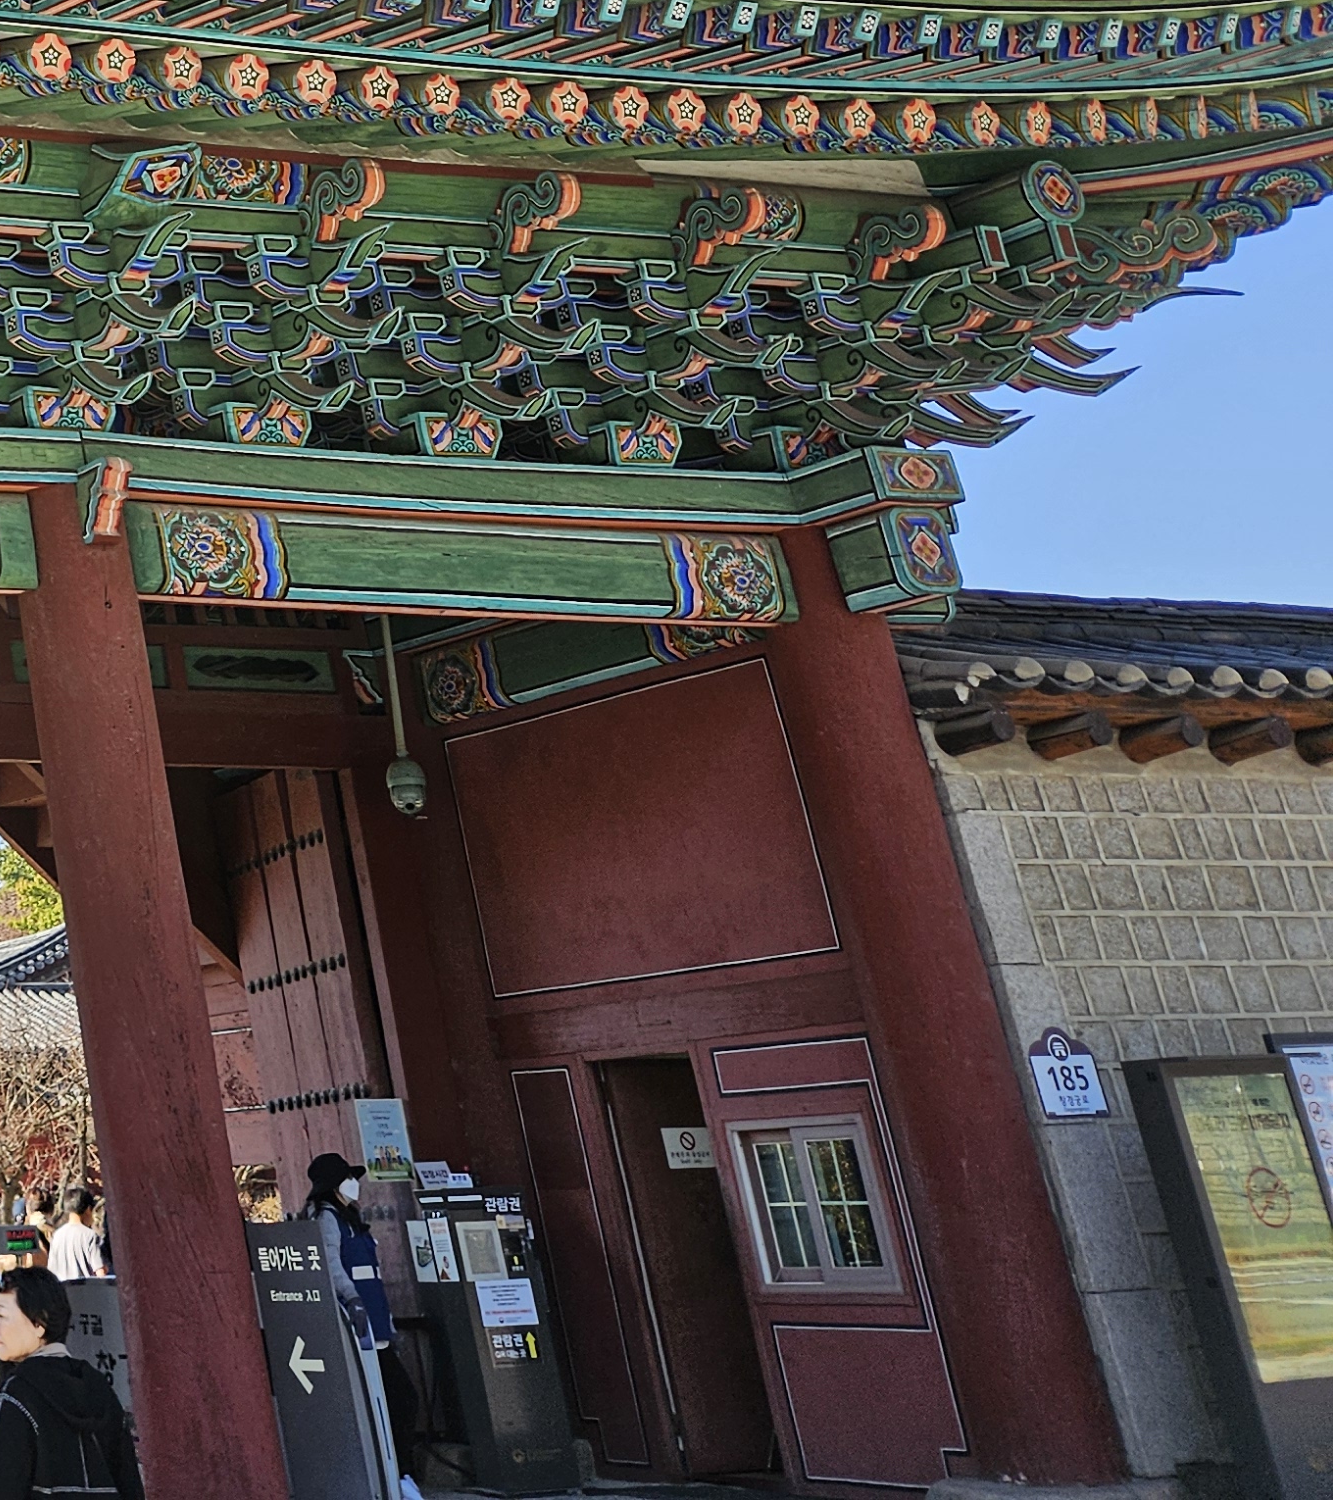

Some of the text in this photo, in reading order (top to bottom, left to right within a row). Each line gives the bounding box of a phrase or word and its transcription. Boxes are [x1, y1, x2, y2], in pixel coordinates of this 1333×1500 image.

[1047, 1065, 1090, 1092] 185
[1058, 1095, 1090, 1107] 창경궁로
[484, 1196, 521, 1213] 관람권
[257, 1245, 322, 1272] 들어가는 곳
[269, 1289, 303, 1302] Entrance
[491, 1333, 524, 1349] 관람권
